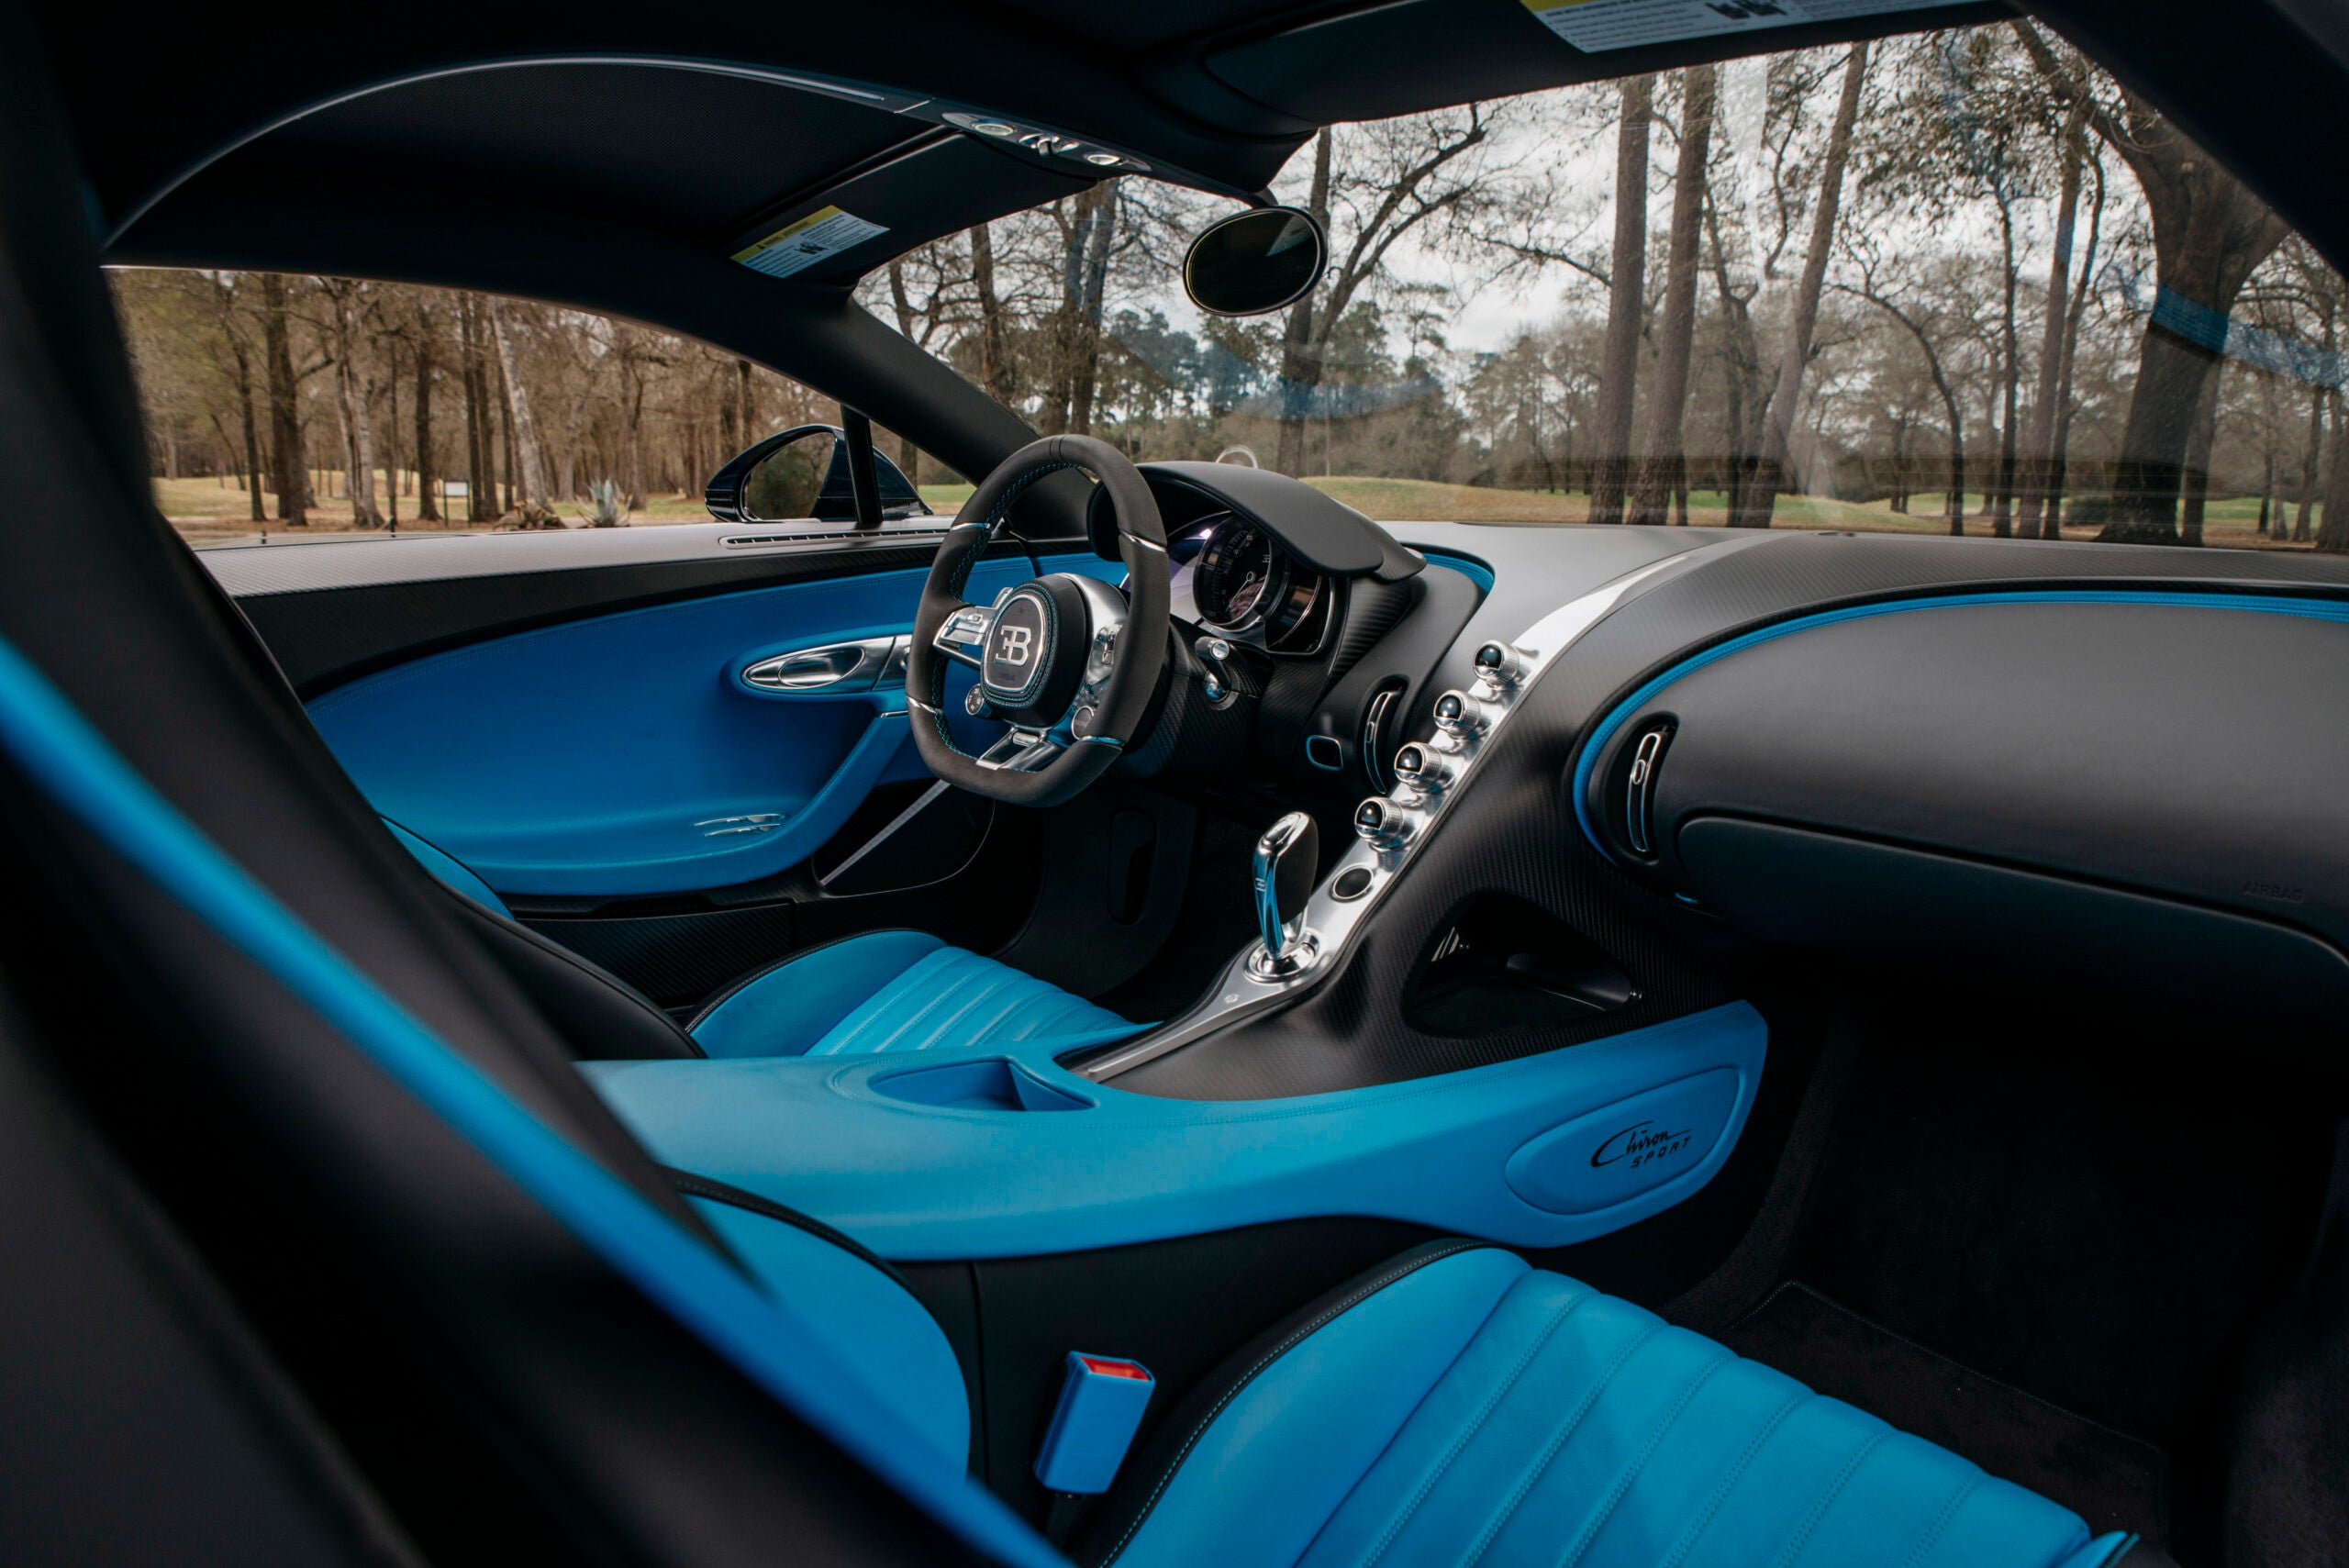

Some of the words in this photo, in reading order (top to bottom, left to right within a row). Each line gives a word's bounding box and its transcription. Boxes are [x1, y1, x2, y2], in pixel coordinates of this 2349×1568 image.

[2240, 881, 2304, 902] AIRBAG
[1590, 1119, 1691, 1168] Chiron
[1629, 1136, 1692, 1169] SPORT
